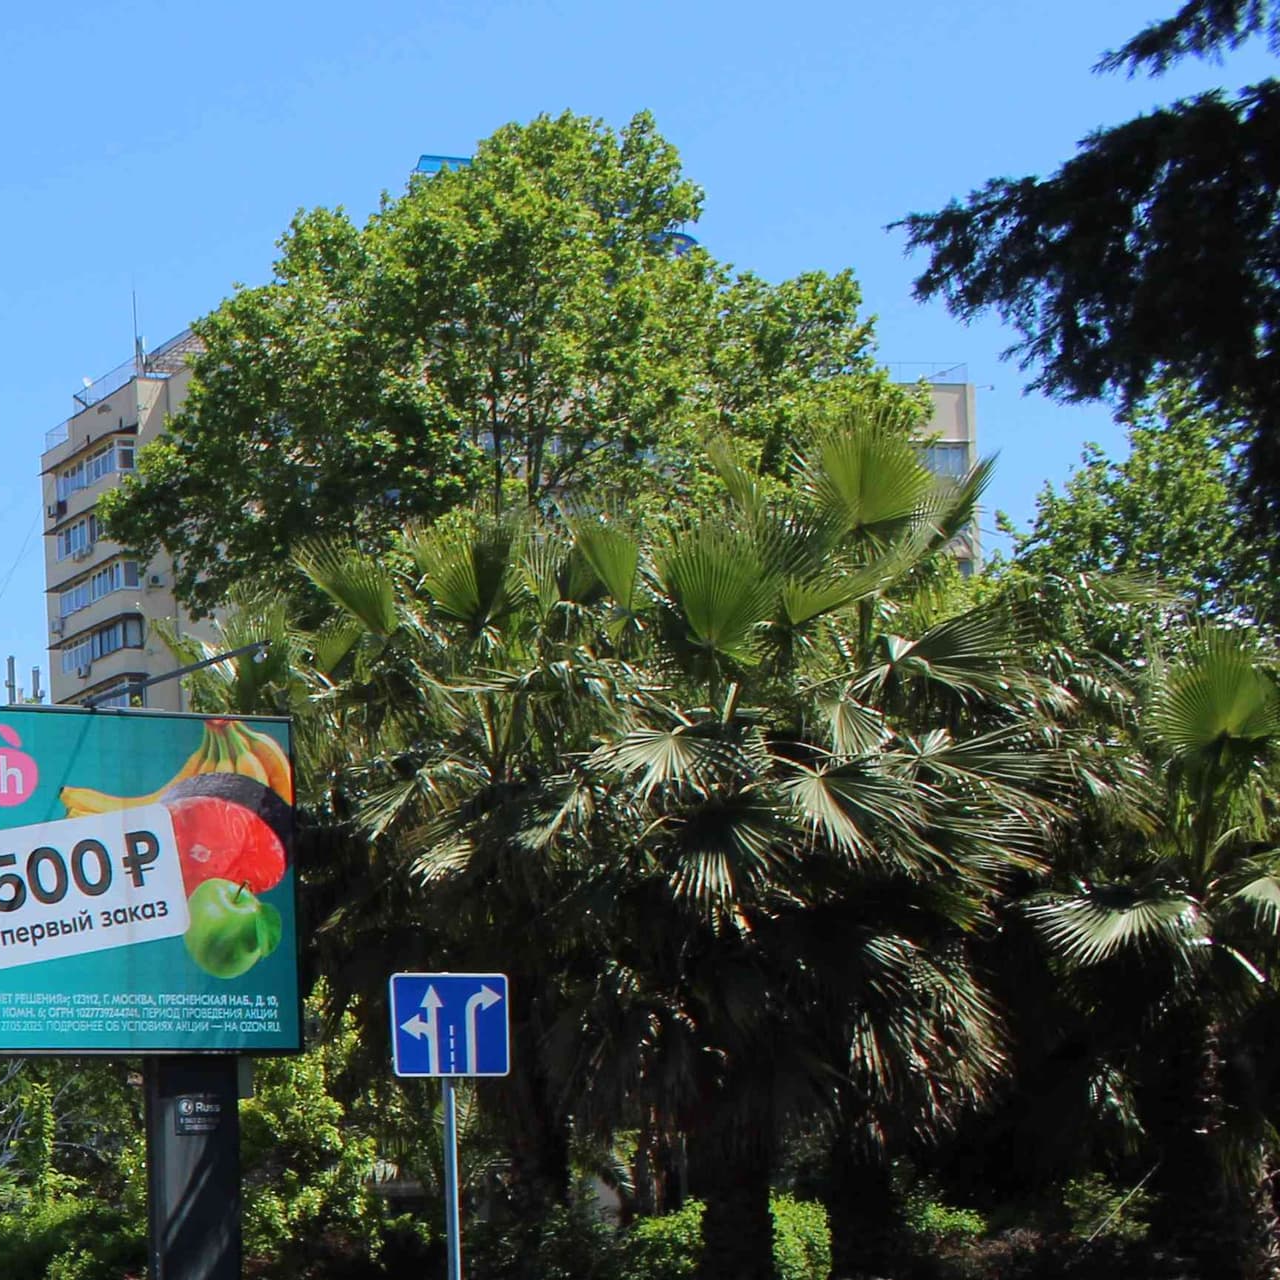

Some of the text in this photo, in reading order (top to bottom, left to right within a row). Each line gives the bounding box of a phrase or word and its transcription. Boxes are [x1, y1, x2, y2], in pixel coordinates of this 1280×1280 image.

[0, 910, 93, 946] первый
[101, 900, 168, 927] заказ
[142, 1008, 180, 1019] ПЕРИОД
[183, 1008, 242, 1019] ПРОВЕДЕНИЯ
[245, 1008, 278, 1020] АКЦИИ
[46, 1020, 104, 1032] ПОДРОБНЕЕ
[121, 1020, 173, 1032] УСЛОВИЯХ
[224, 1021, 238, 1031] НА
